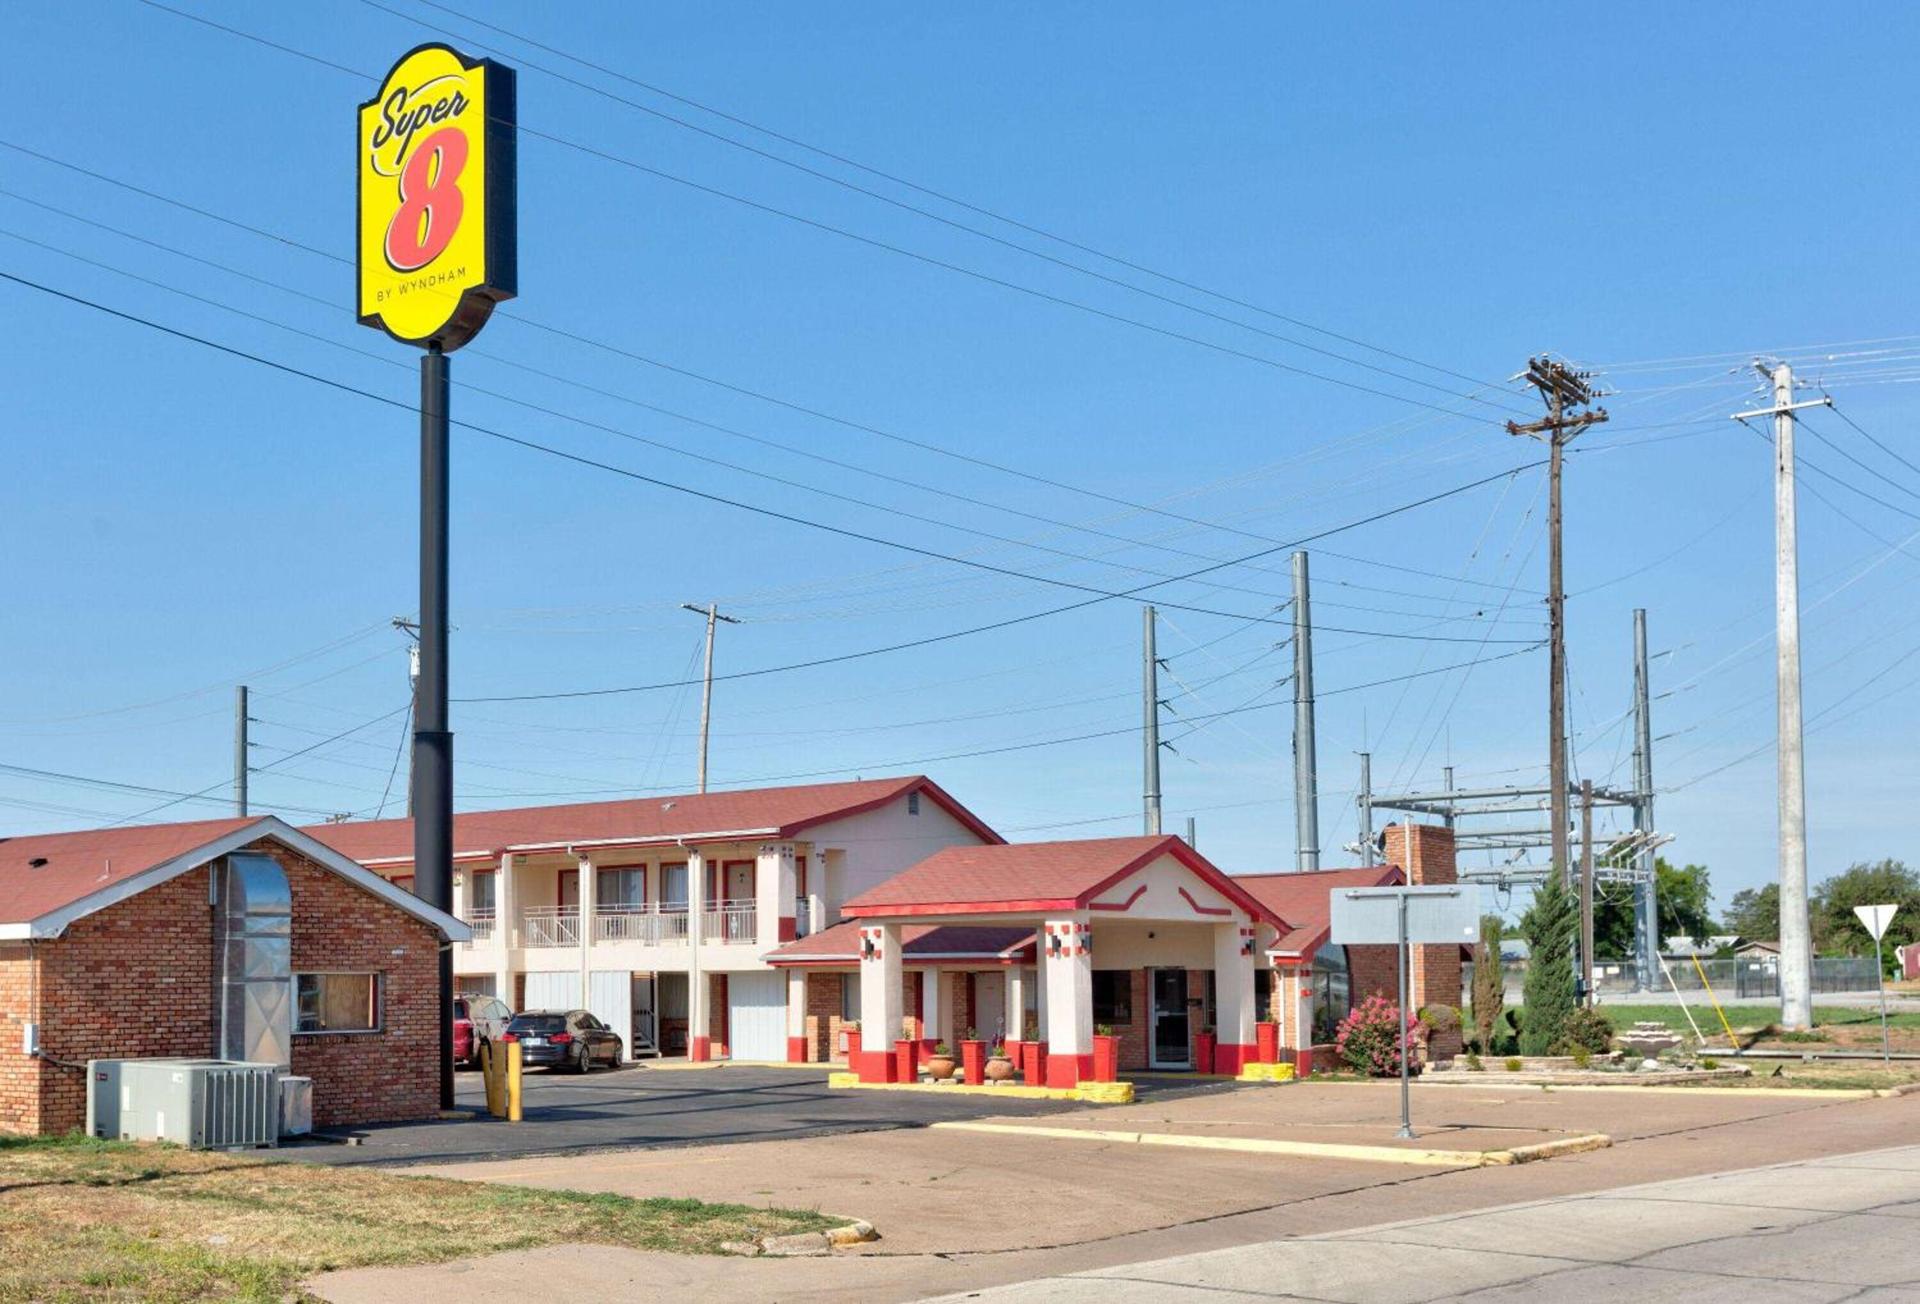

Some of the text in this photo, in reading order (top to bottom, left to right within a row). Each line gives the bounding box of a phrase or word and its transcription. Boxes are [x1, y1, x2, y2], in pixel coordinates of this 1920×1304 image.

[373, 86, 470, 165] Super
[384, 126, 469, 273] 8
[376, 266, 467, 301] BY WYNDHAM
